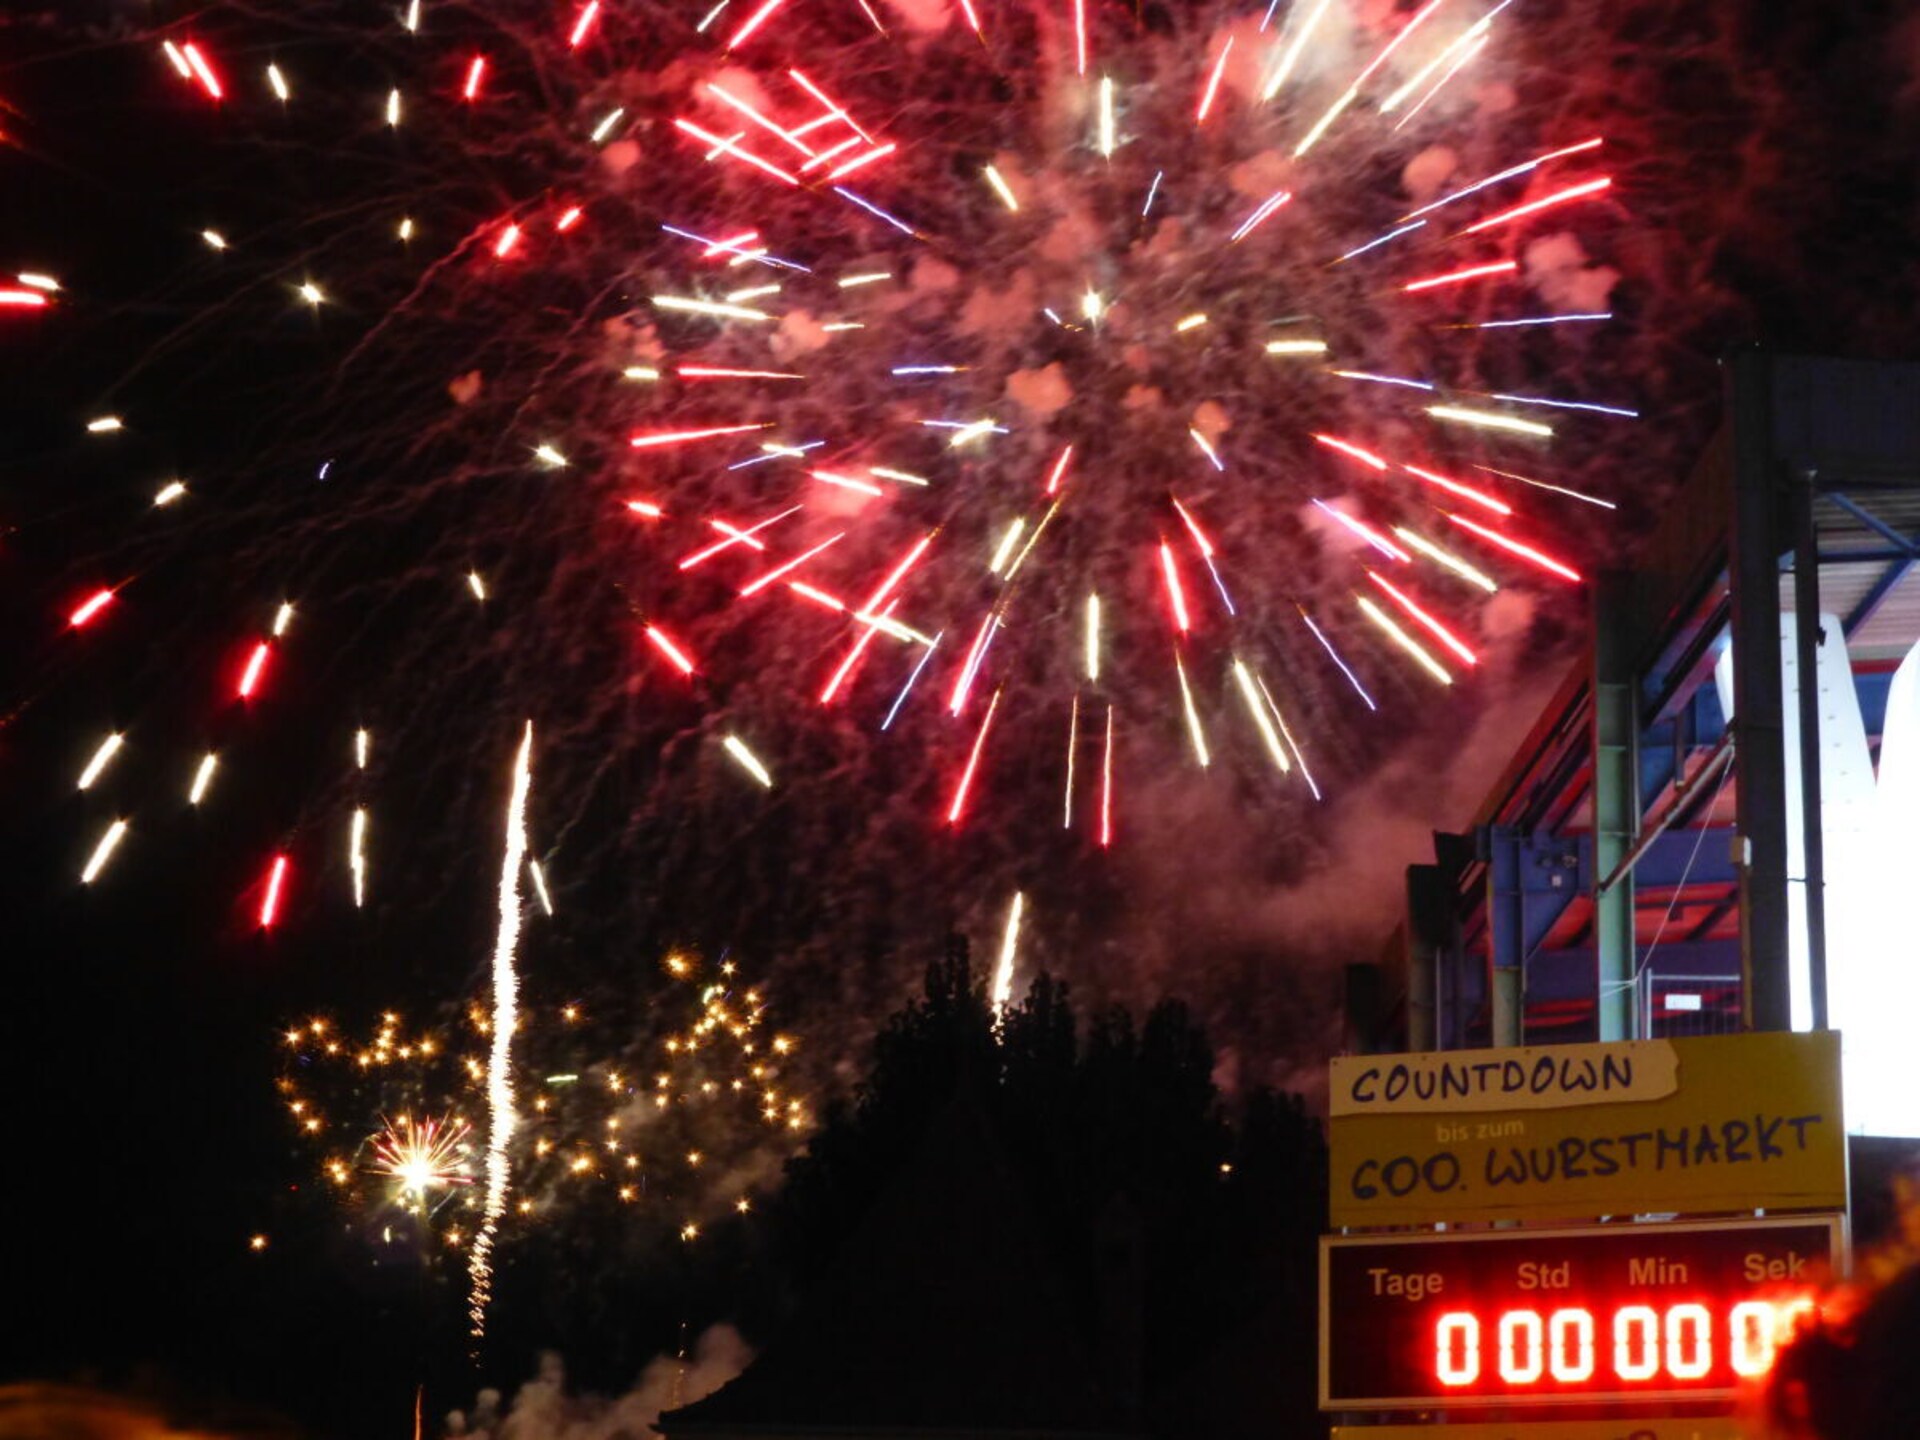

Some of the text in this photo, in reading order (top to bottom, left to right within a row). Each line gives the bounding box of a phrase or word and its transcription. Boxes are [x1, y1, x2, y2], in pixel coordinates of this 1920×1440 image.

[1351, 1055, 1633, 1102] COUNTDOWN
[1436, 1120, 1524, 1142] bis zum
[1484, 1114, 1822, 1187] WURSTMARKT
[1368, 1251, 1806, 1300] Tage Std Min Sek
[1436, 1298, 1811, 1386] 0 00 00 0
